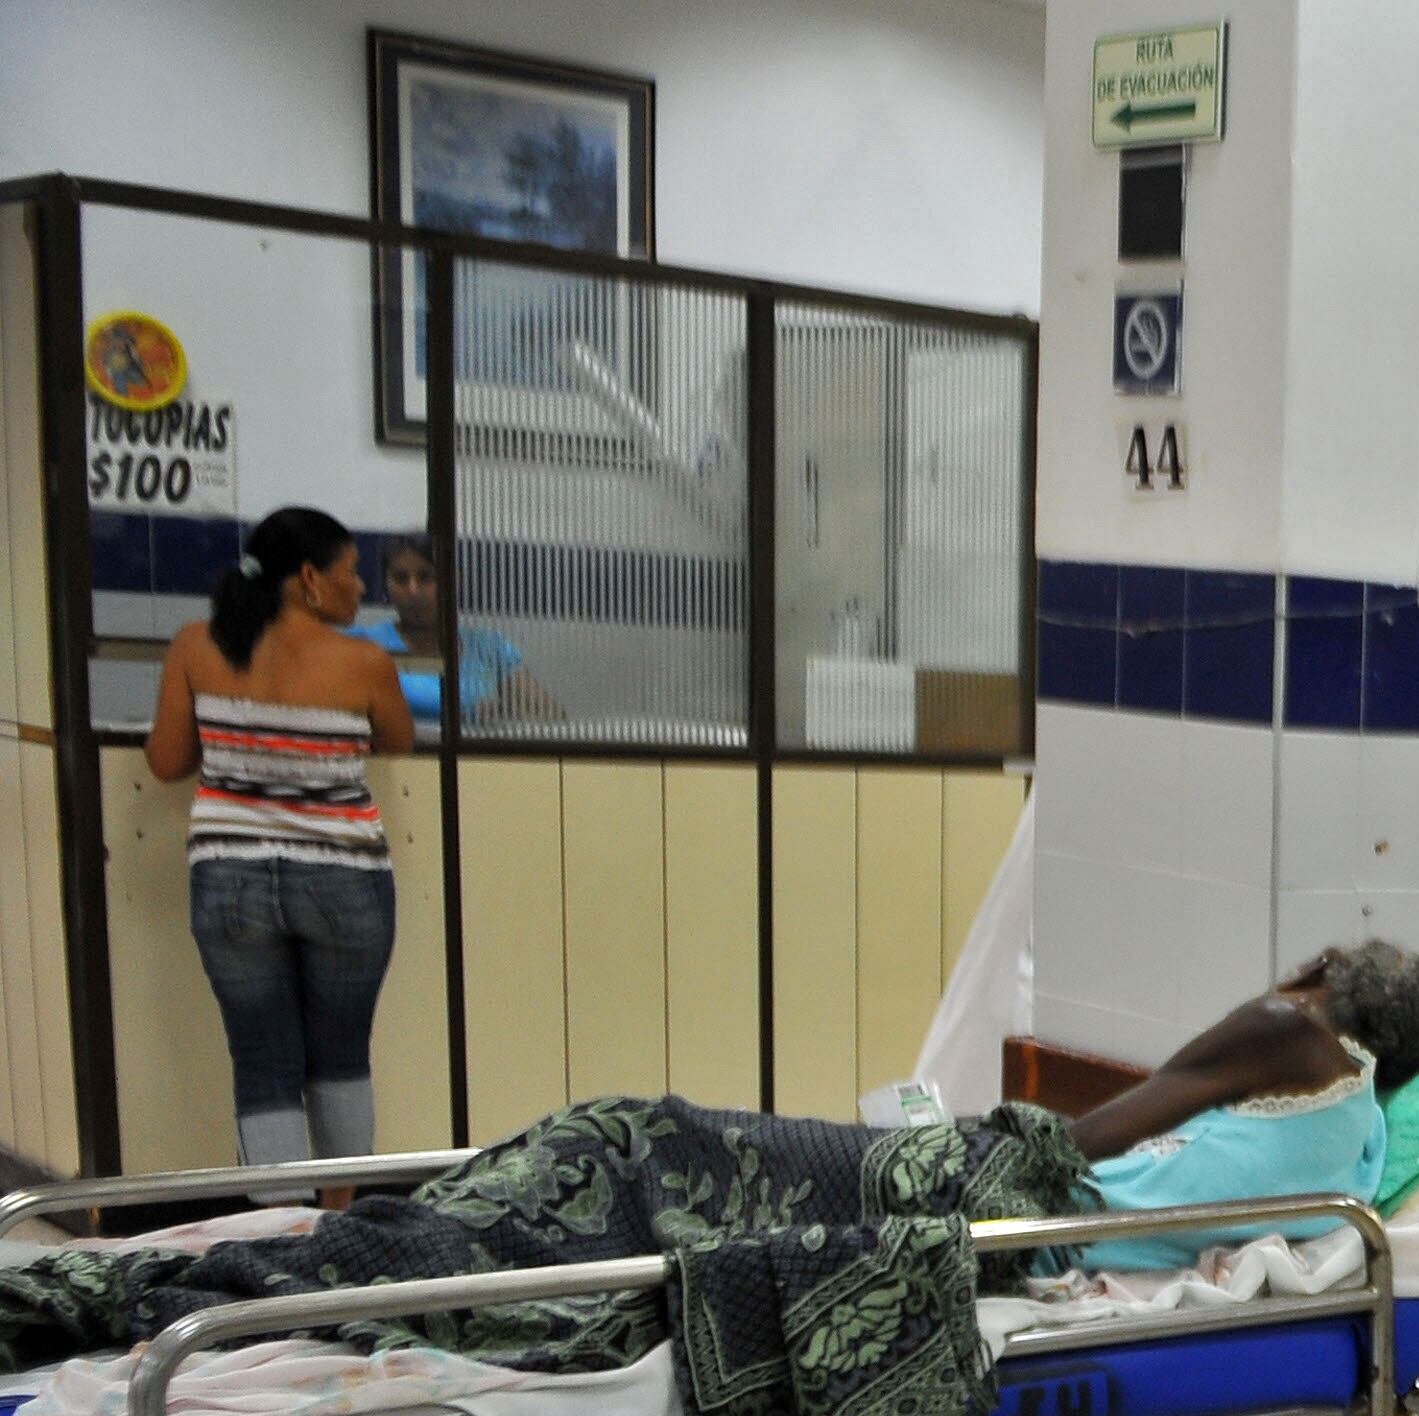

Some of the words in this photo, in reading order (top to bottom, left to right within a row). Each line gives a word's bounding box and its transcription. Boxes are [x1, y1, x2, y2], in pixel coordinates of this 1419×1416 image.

[1135, 34, 1174, 63] RUTA
[1097, 76, 1116, 100] DE
[1119, 62, 1214, 98] EVACUACIÓN
[88, 452, 191, 504] $100
[1125, 424, 1185, 490] 44
